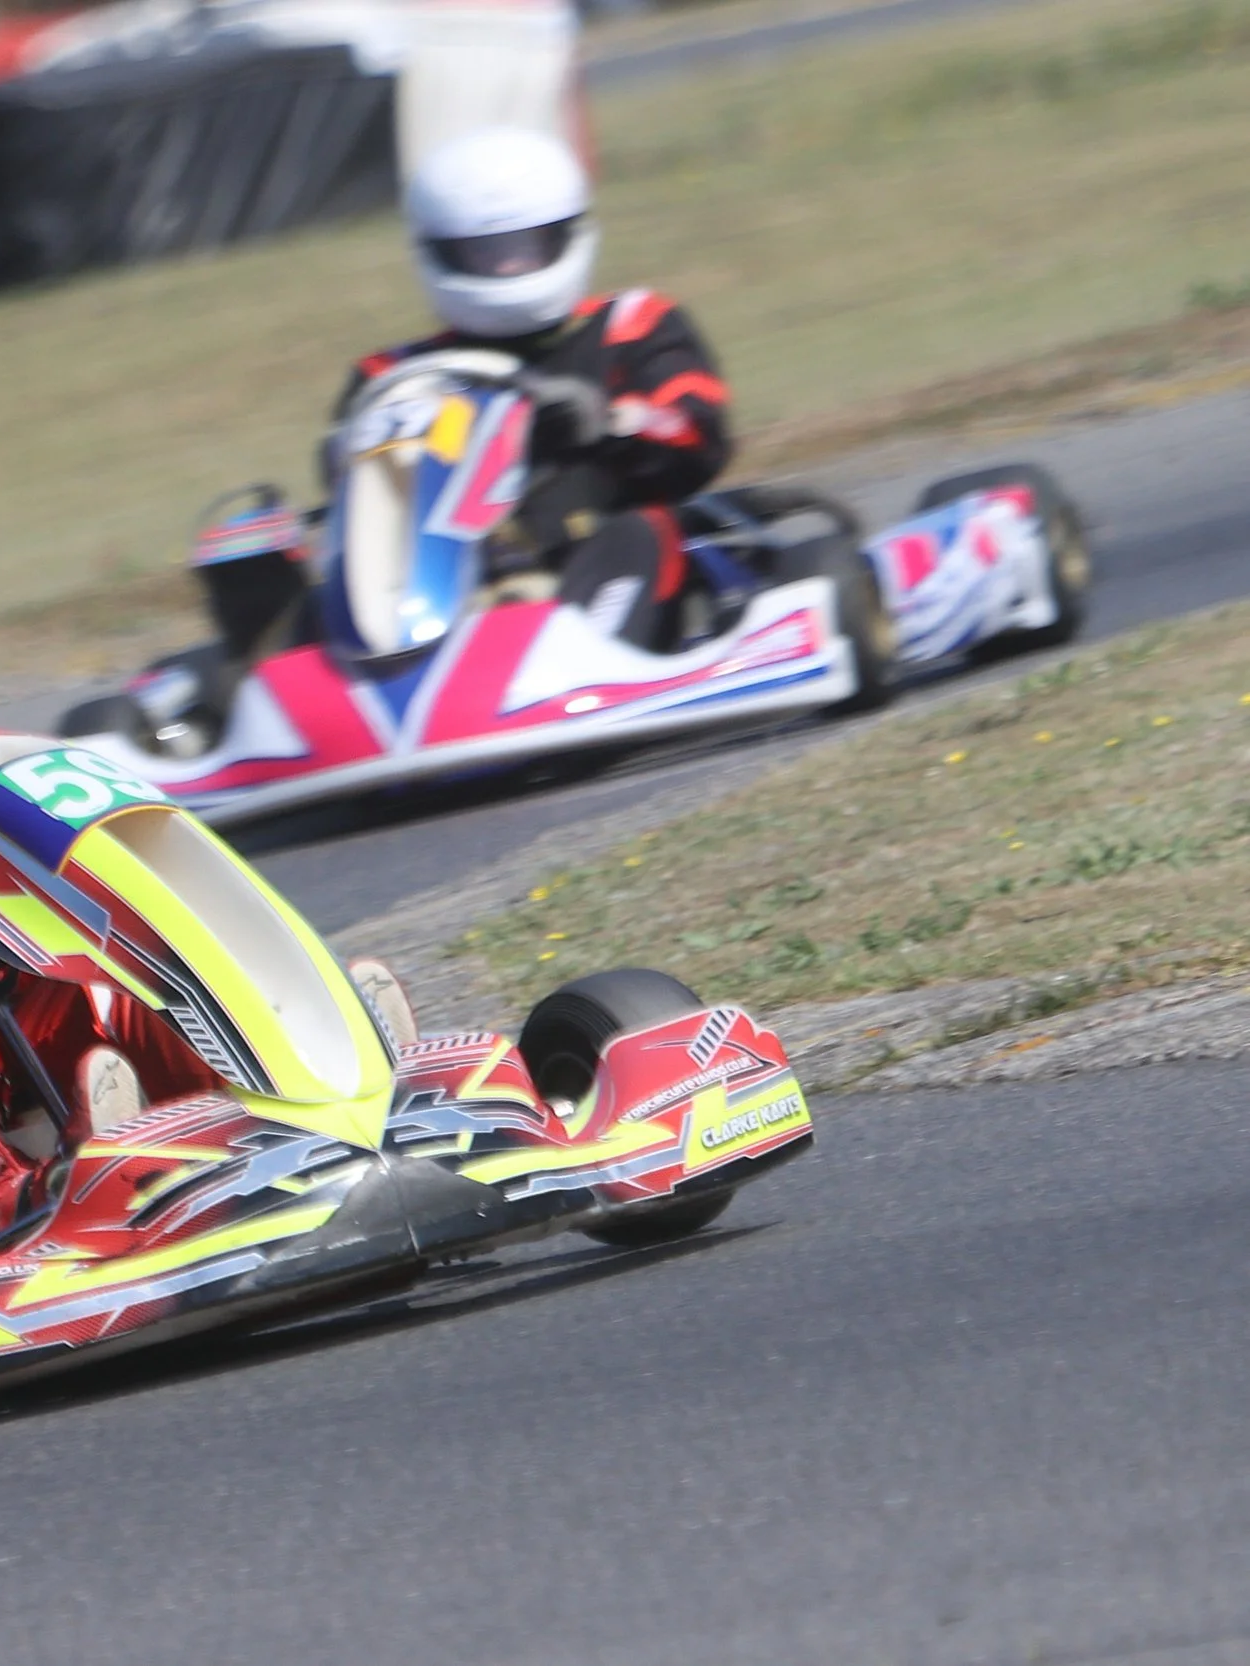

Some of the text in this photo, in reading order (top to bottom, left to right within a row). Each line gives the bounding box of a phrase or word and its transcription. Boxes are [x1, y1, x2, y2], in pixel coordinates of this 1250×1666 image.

[2, 751, 166, 818] 59
[701, 1094, 801, 1148] CLARKE KARTS
